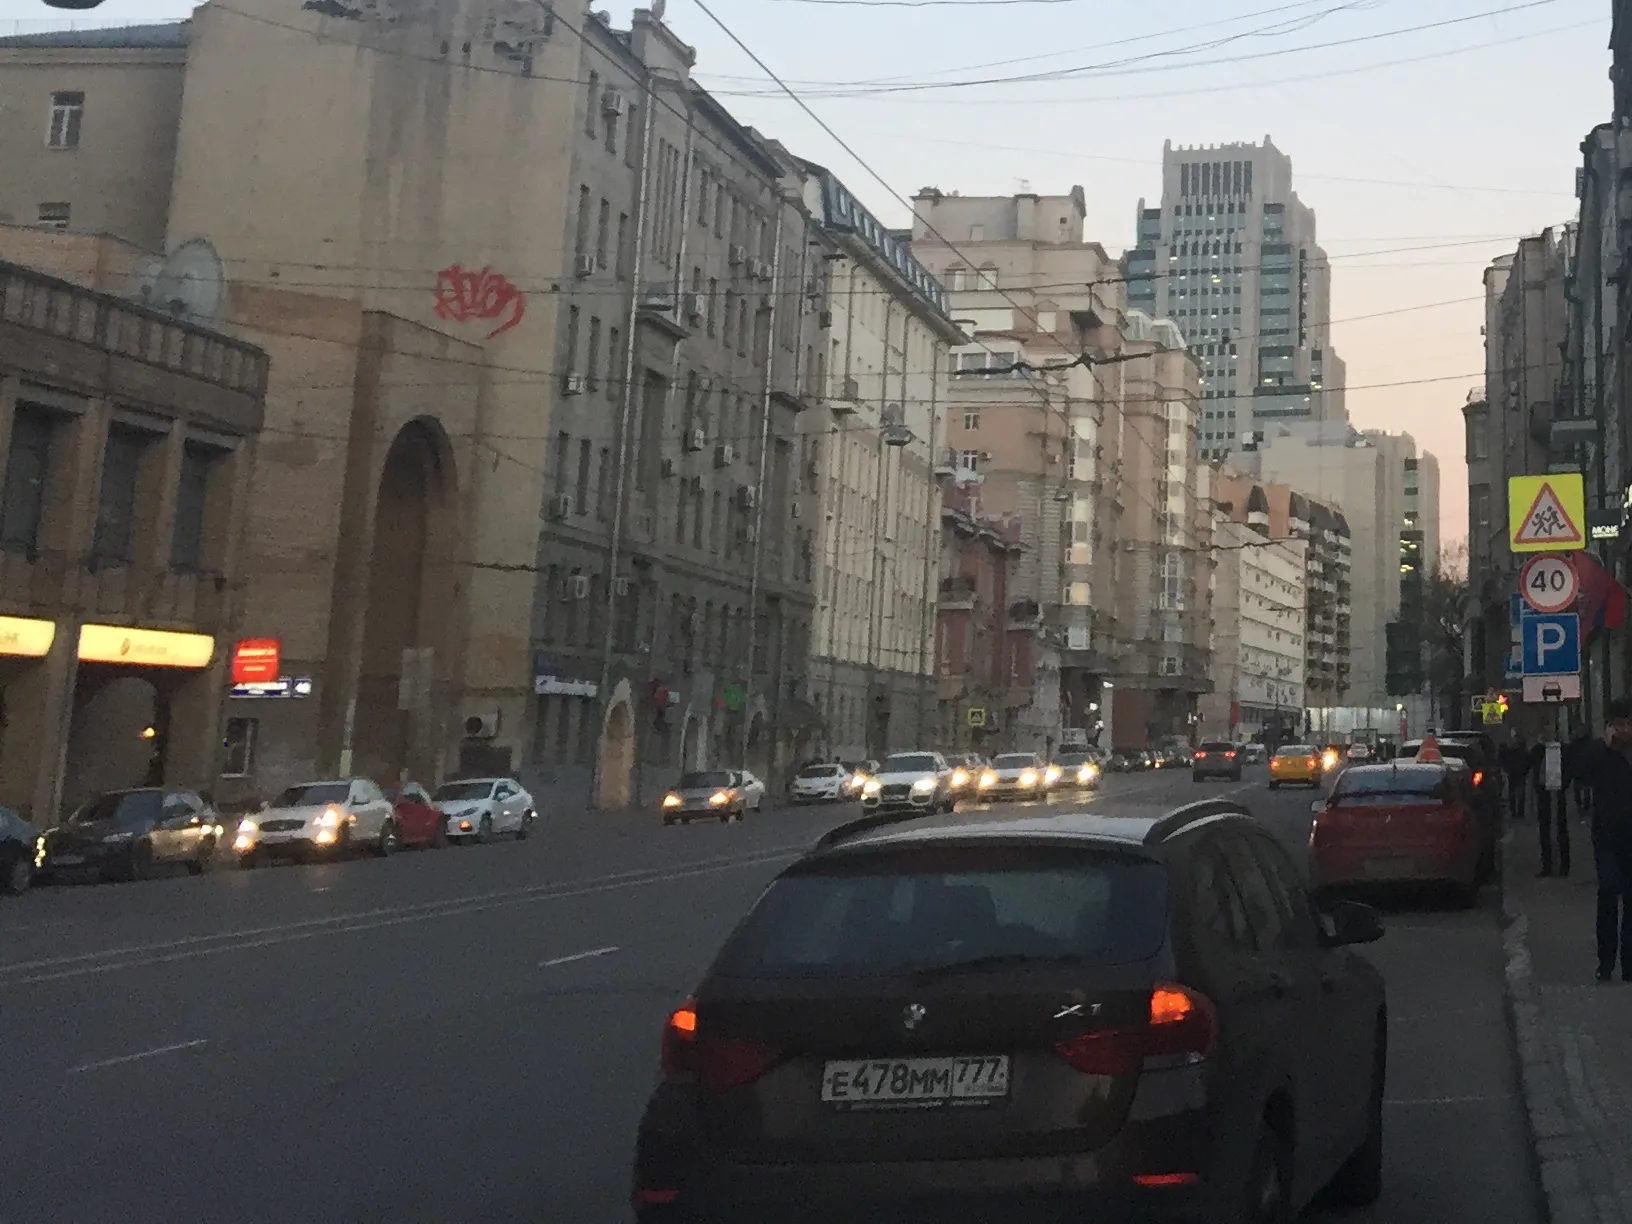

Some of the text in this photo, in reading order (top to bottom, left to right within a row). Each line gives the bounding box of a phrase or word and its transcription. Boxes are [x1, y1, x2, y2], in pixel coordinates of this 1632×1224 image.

[1530, 569, 1566, 592] 40
[1537, 623, 1567, 666] P
[1053, 1003, 1102, 1019] X1
